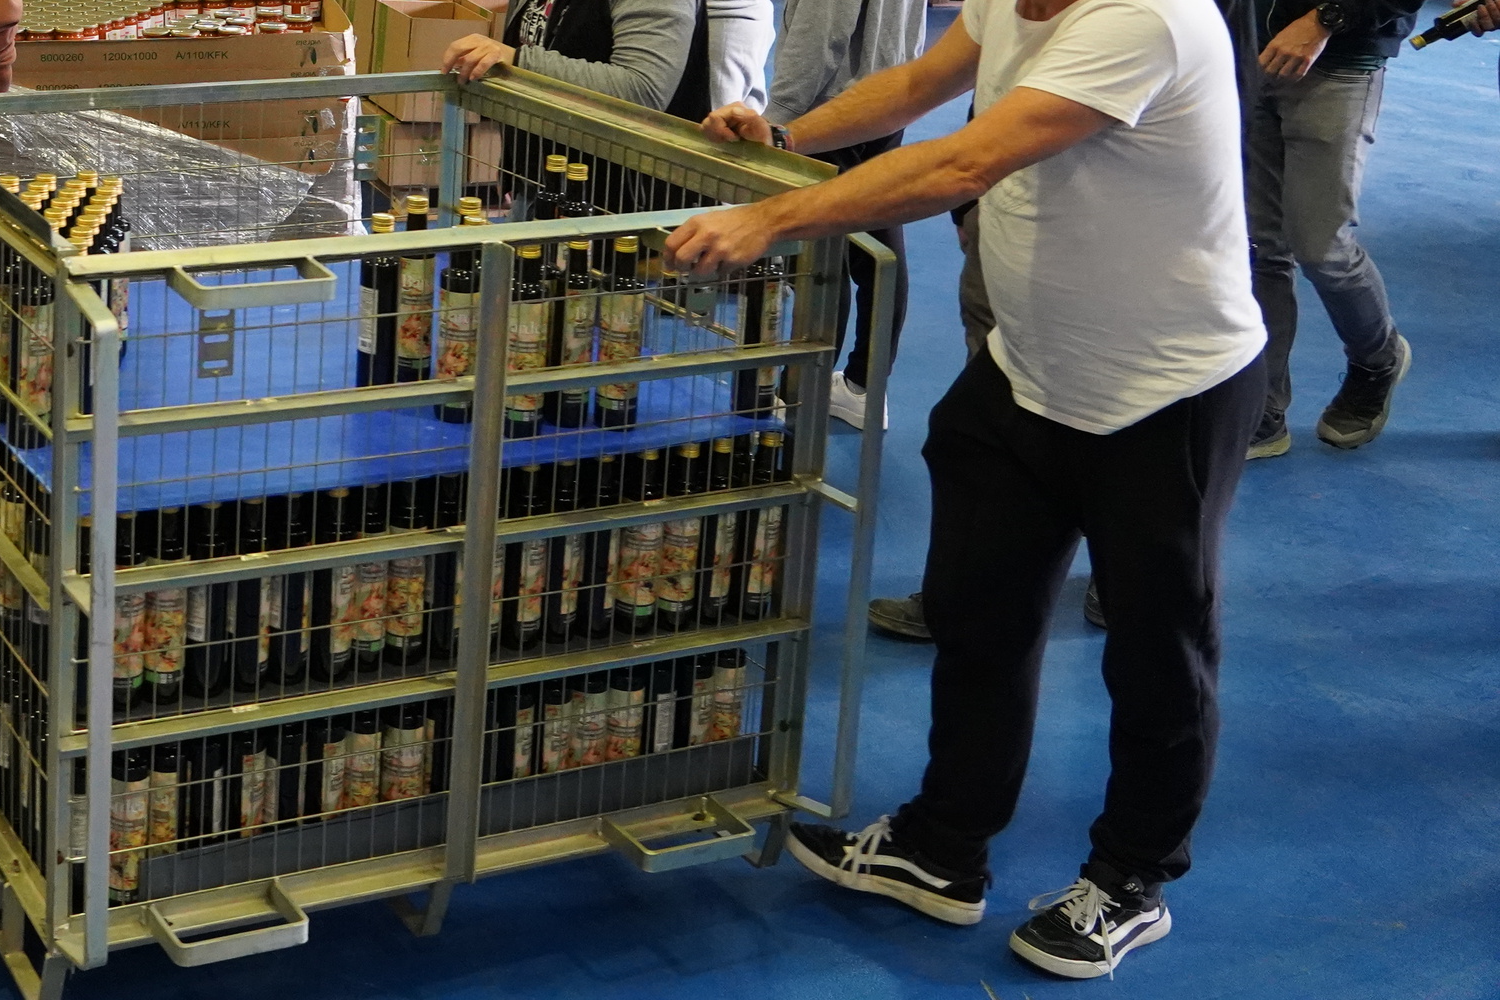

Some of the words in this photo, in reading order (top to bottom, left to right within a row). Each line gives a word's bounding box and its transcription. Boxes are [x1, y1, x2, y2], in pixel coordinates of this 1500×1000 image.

[40, 52, 85, 62] 8000260
[103, 51, 158, 61] 1200x1000
[175, 50, 229, 60] A/110/KFK
